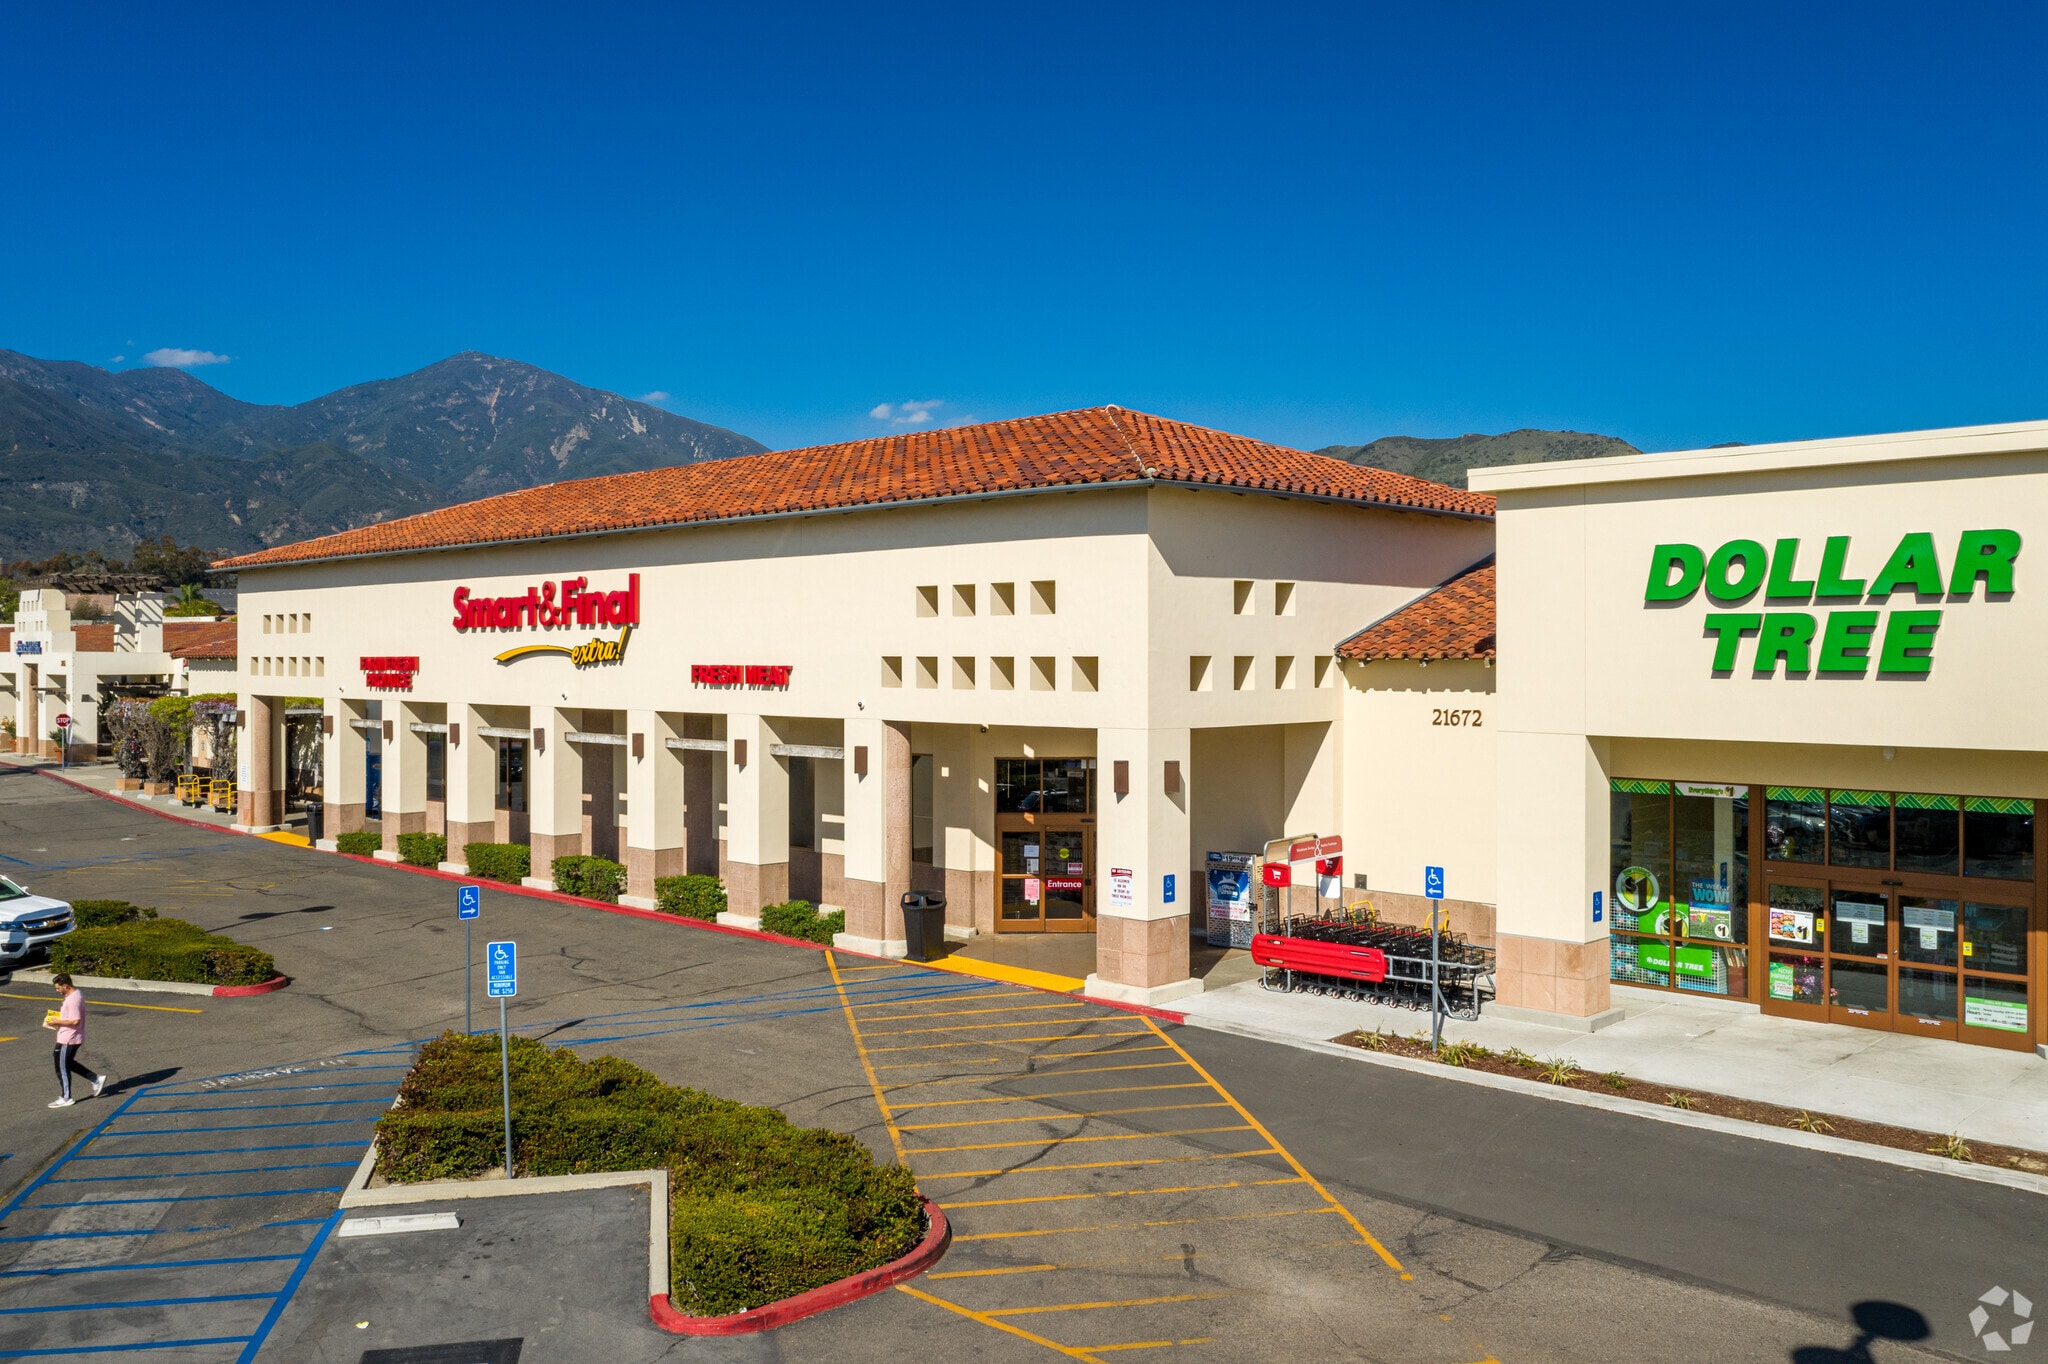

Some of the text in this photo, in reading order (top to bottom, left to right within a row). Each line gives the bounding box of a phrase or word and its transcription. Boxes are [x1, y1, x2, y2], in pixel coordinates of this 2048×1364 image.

[1645, 529, 2021, 606] DOLLAR
[571, 626, 629, 665] extra!
[1704, 611, 1941, 678] TREE
[691, 665, 793, 686] FRESH MEAT
[1432, 708, 1483, 727] 21672
[1047, 880, 1082, 888] Entrance
[1692, 881, 1704, 889] THE
[1692, 888, 1730, 903] WOW!
[1718, 925, 1726, 937] $1
[1684, 962, 1704, 972] TREE
